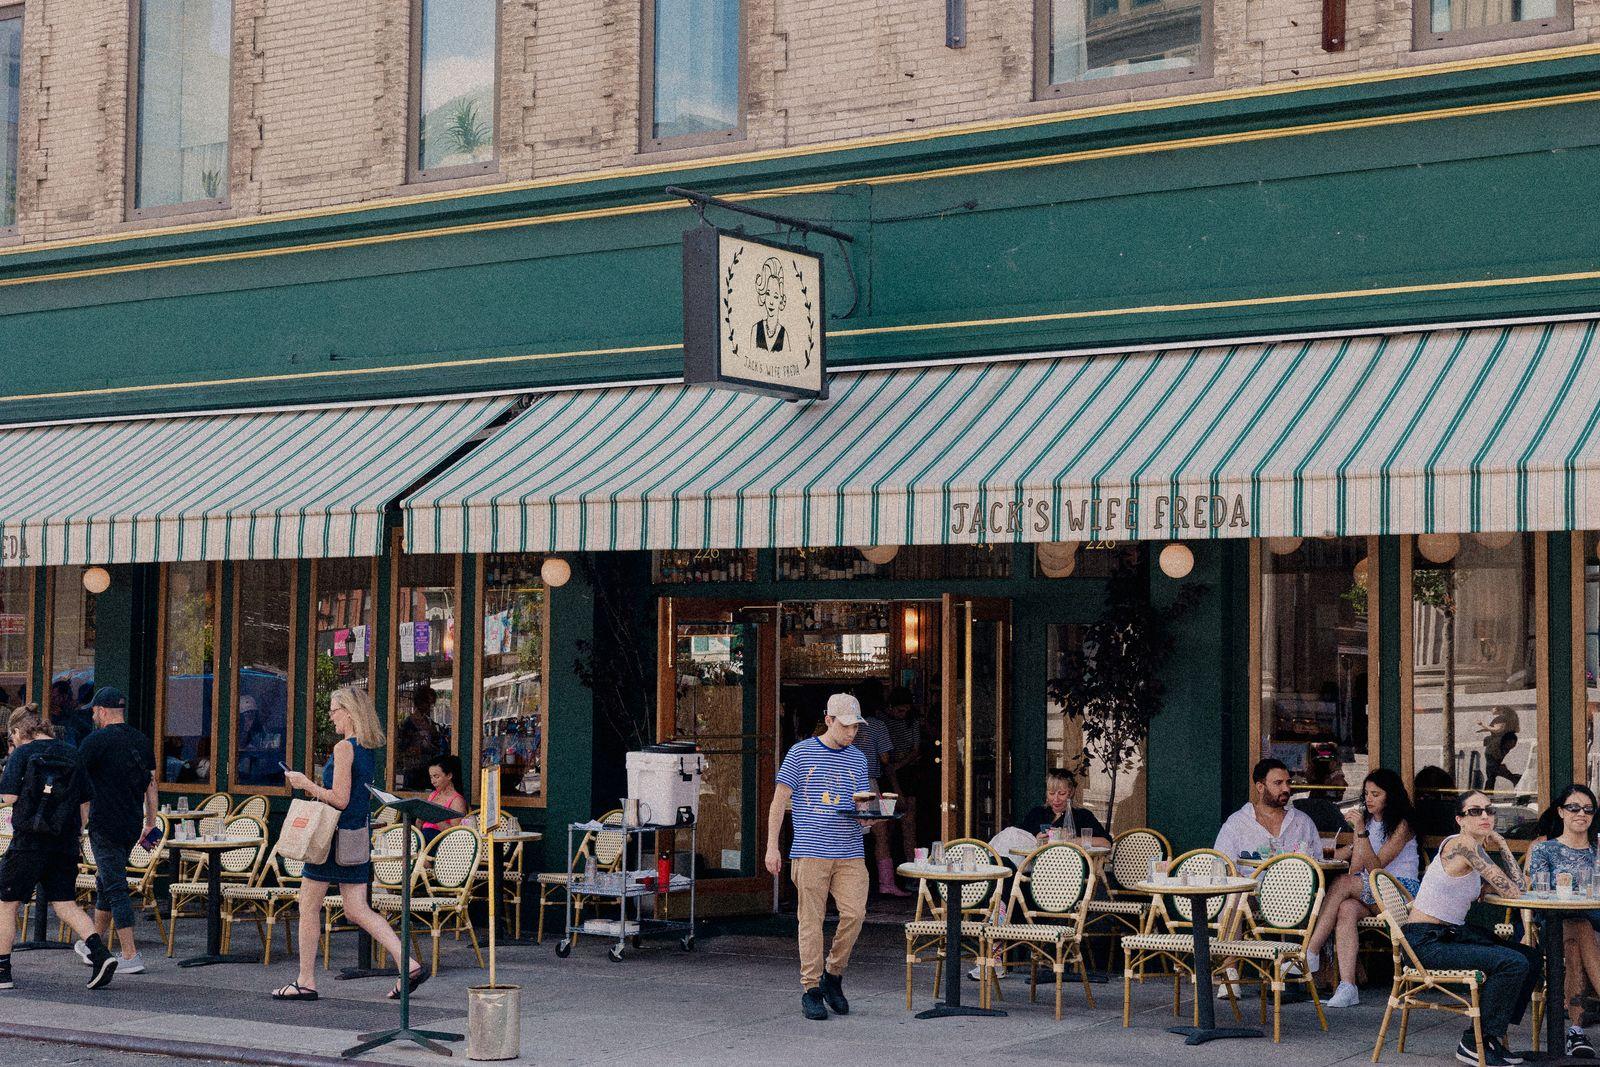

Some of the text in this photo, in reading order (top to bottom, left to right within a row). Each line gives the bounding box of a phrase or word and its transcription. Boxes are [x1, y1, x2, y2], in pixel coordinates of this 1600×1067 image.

[766, 364, 781, 378] WIFE
[782, 364, 801, 377] FREDA
[951, 494, 1249, 533] JACK'S WIFE FREDA
